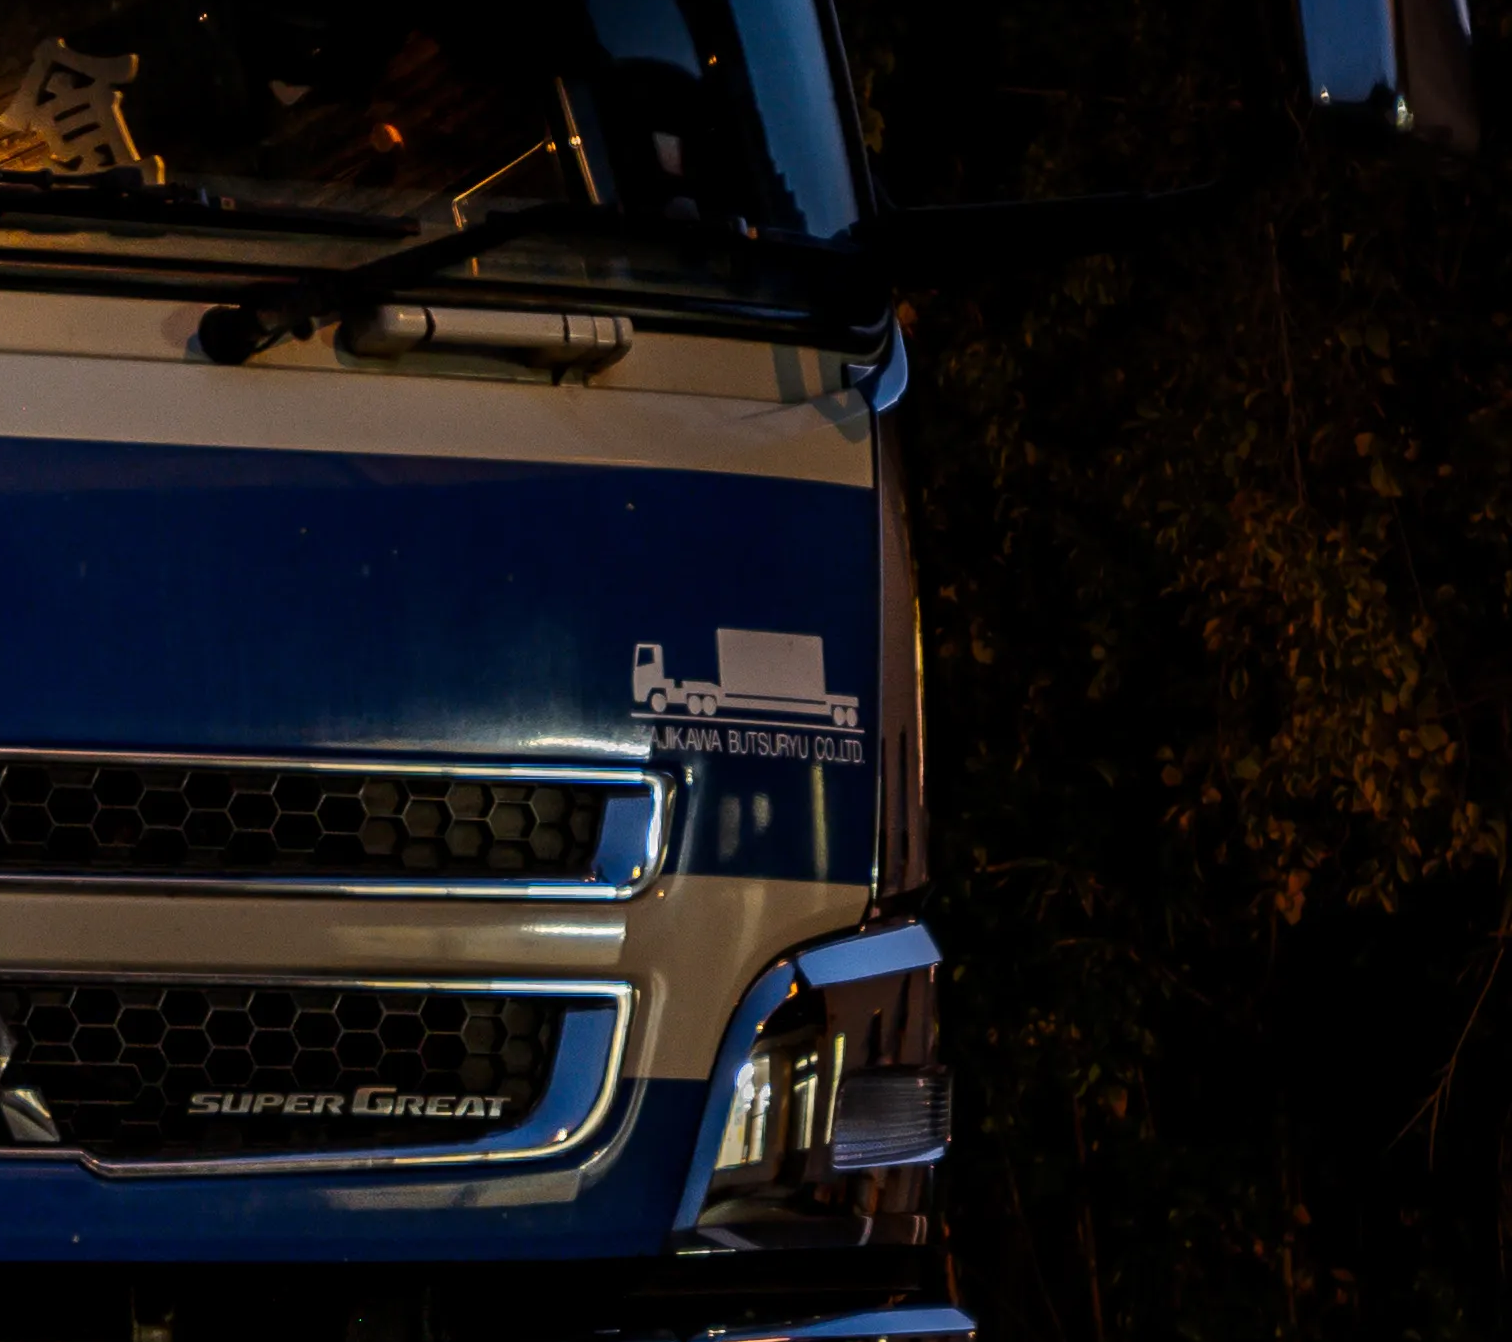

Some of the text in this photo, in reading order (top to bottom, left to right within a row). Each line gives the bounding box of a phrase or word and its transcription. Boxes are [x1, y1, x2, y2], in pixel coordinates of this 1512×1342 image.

[727, 728, 809, 760] BUTSURYU
[186, 1084, 512, 1120] SUPER GREAT
